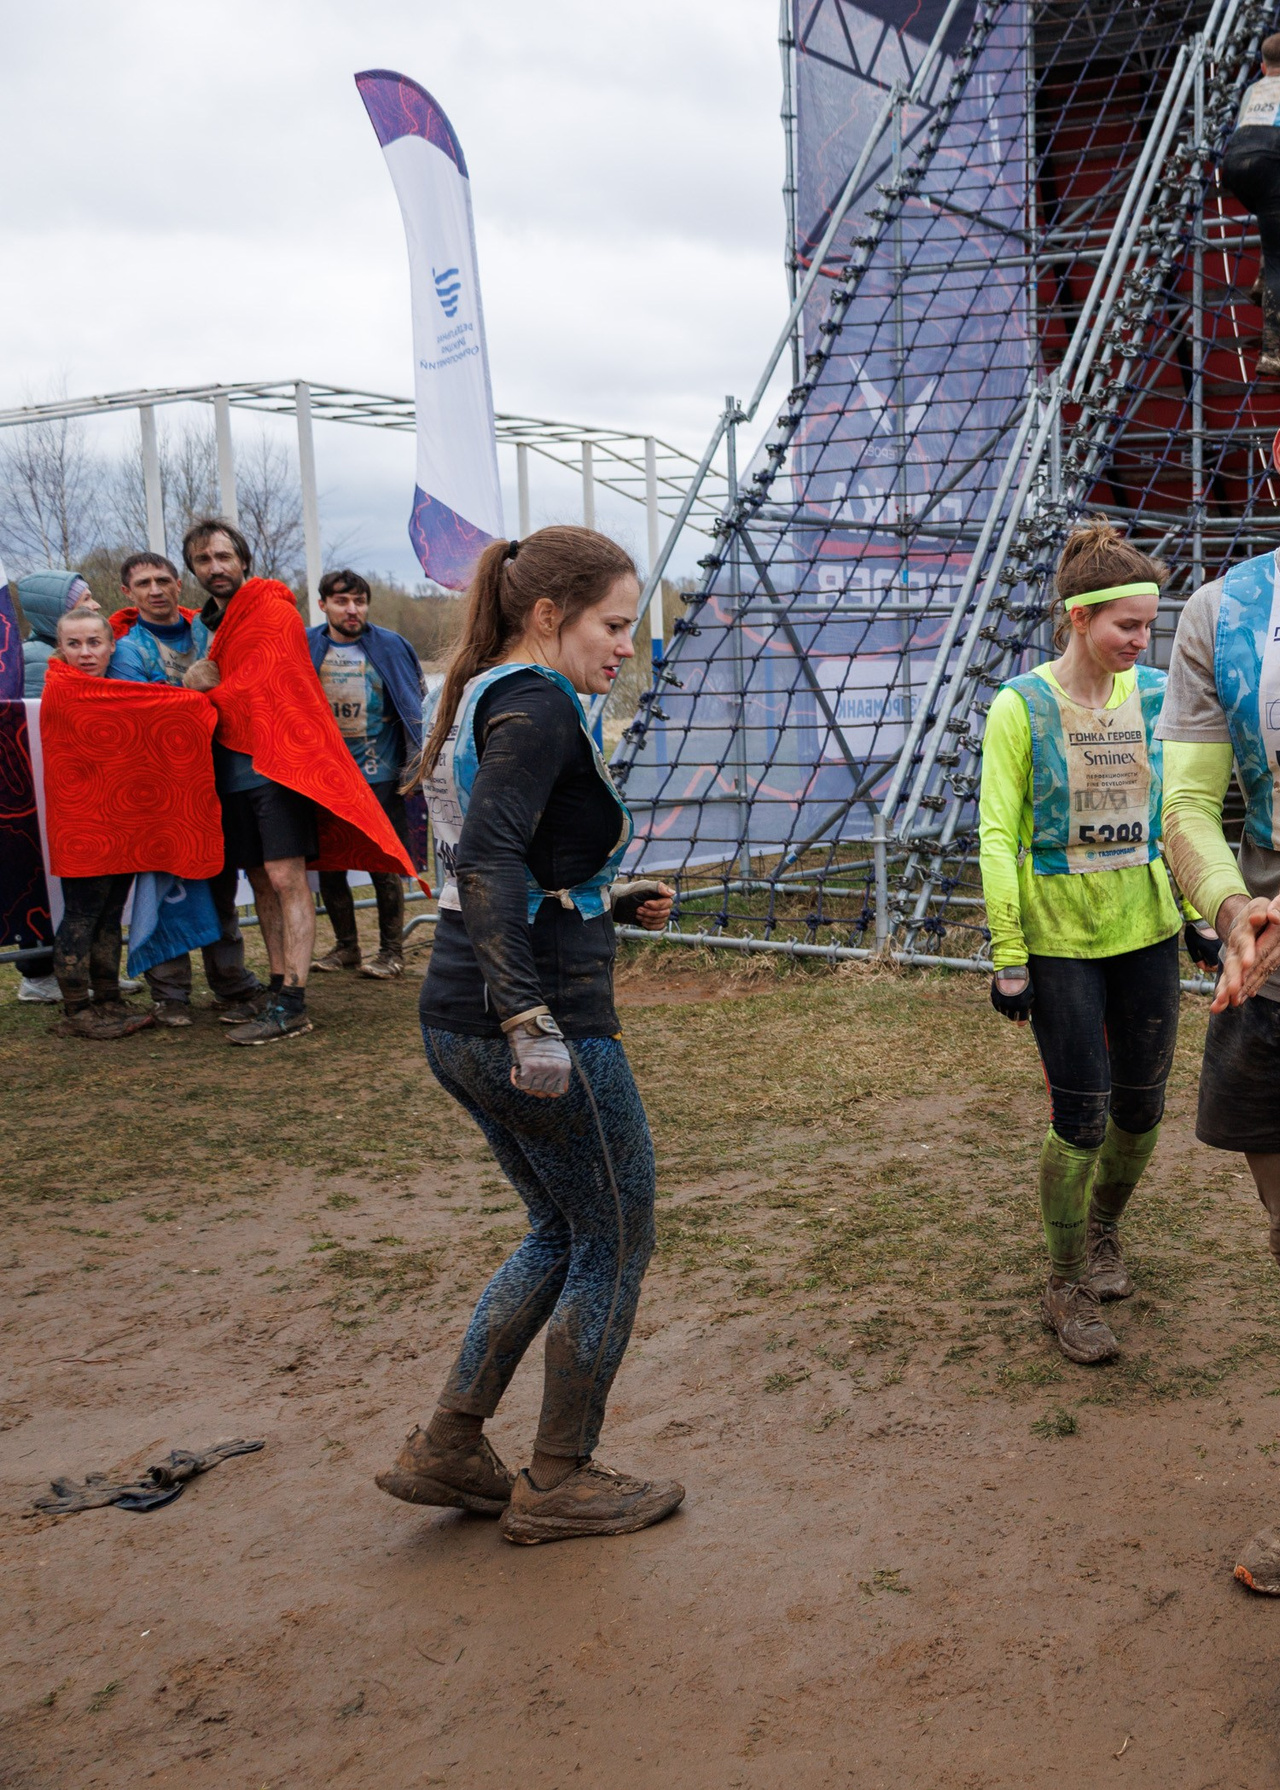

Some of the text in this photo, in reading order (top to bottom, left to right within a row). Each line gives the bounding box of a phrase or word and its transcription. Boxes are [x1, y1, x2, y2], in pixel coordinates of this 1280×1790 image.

[329, 702, 362, 718] 167
[1069, 731, 1142, 742] ГОНКА ГЕРОЕВ
[1084, 750, 1136, 766] Sminex
